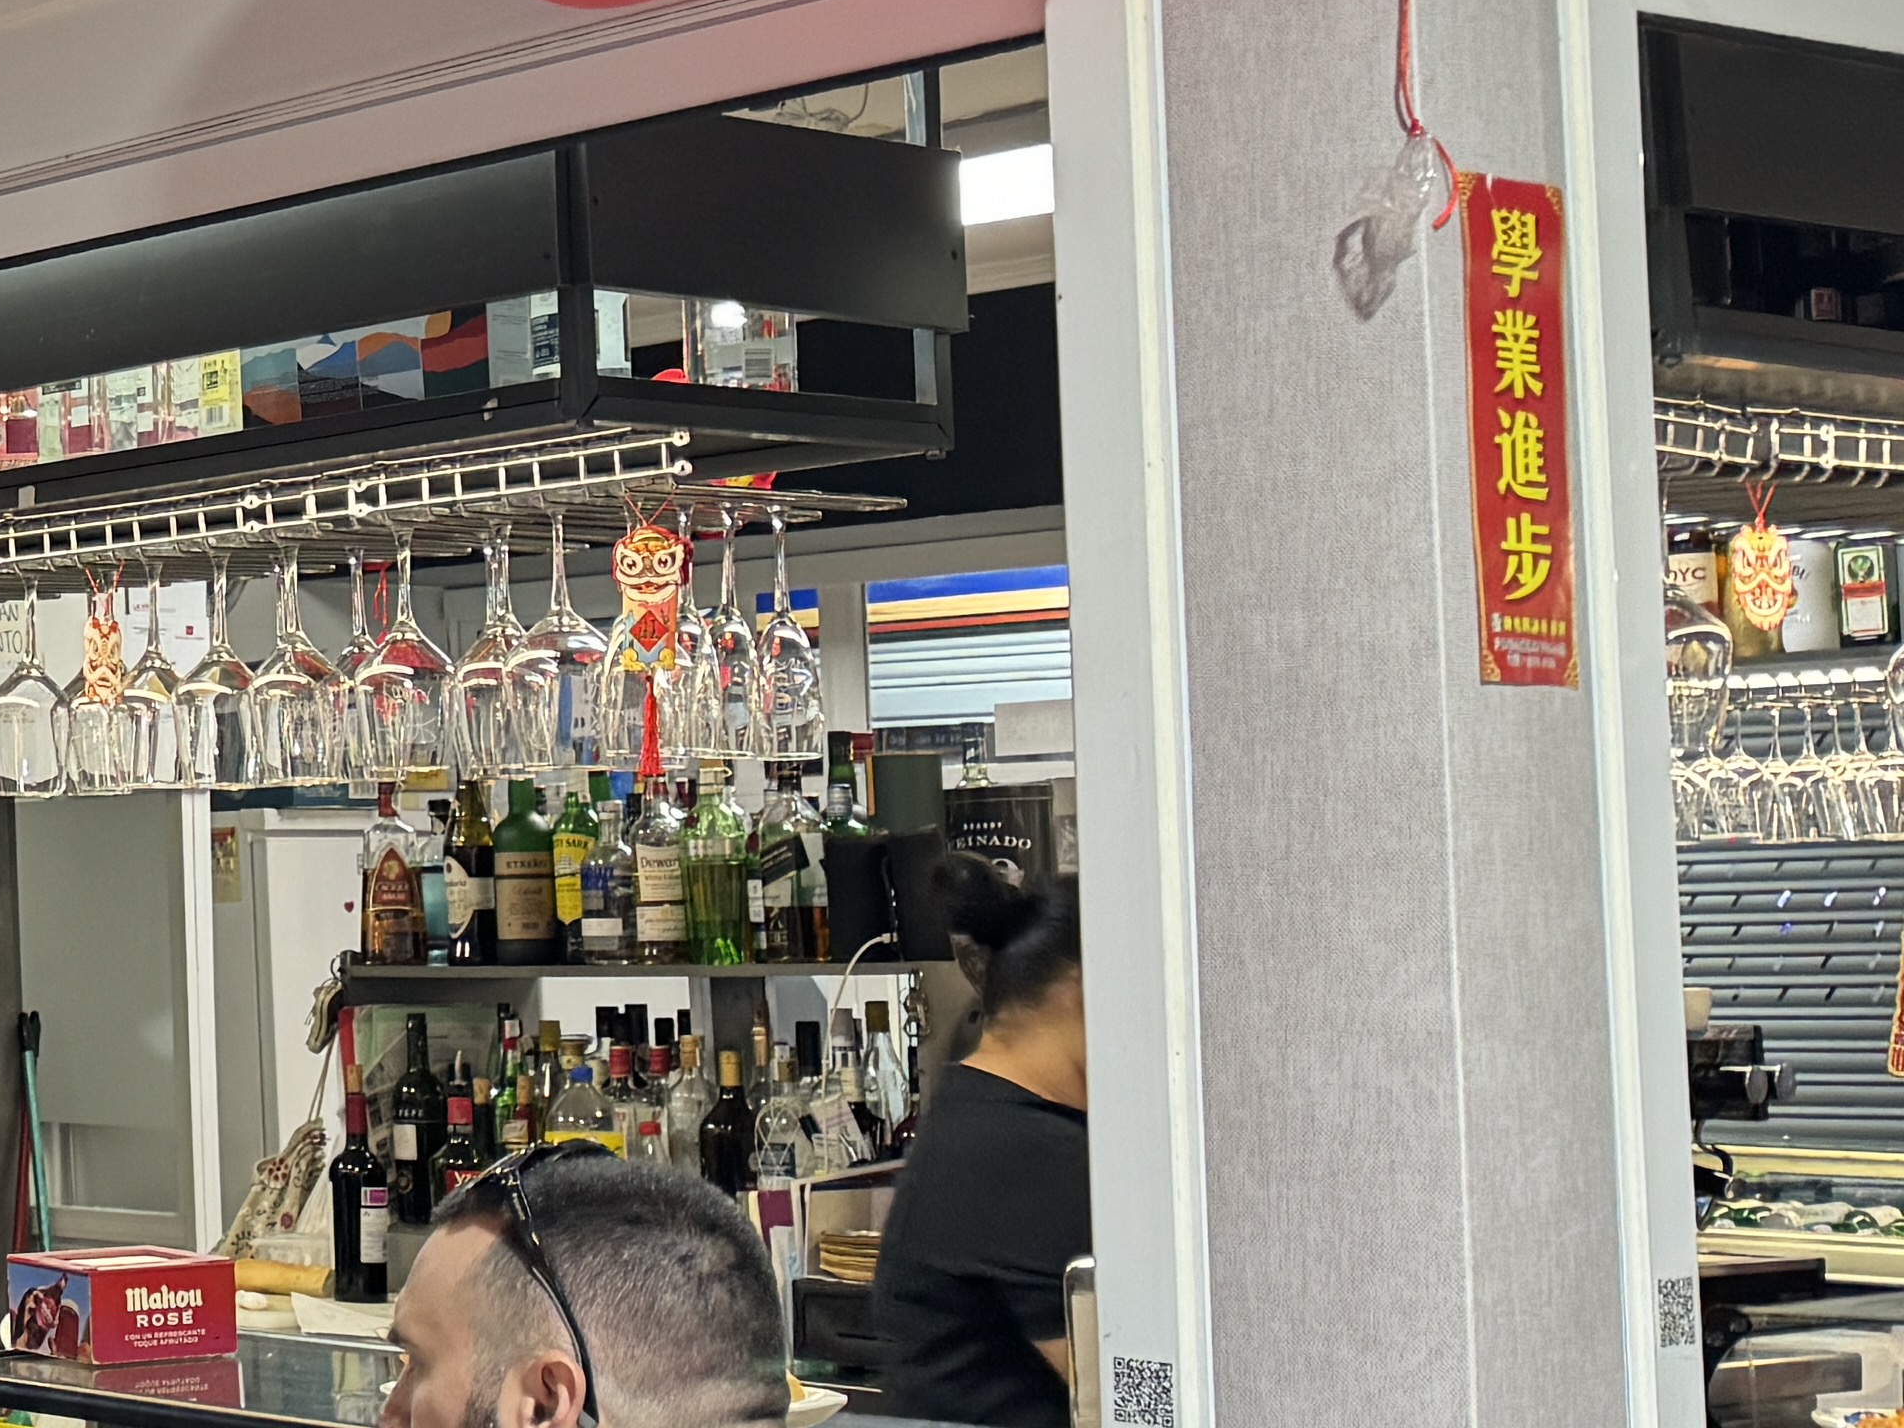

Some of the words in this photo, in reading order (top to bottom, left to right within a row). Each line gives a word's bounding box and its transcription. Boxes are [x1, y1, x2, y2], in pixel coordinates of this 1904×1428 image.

[1490, 208, 1553, 600] 學業進步
[948, 835, 1032, 850] EINADO
[125, 1284, 203, 1312] Mahou
[136, 1309, 193, 1328] ROSÉ
